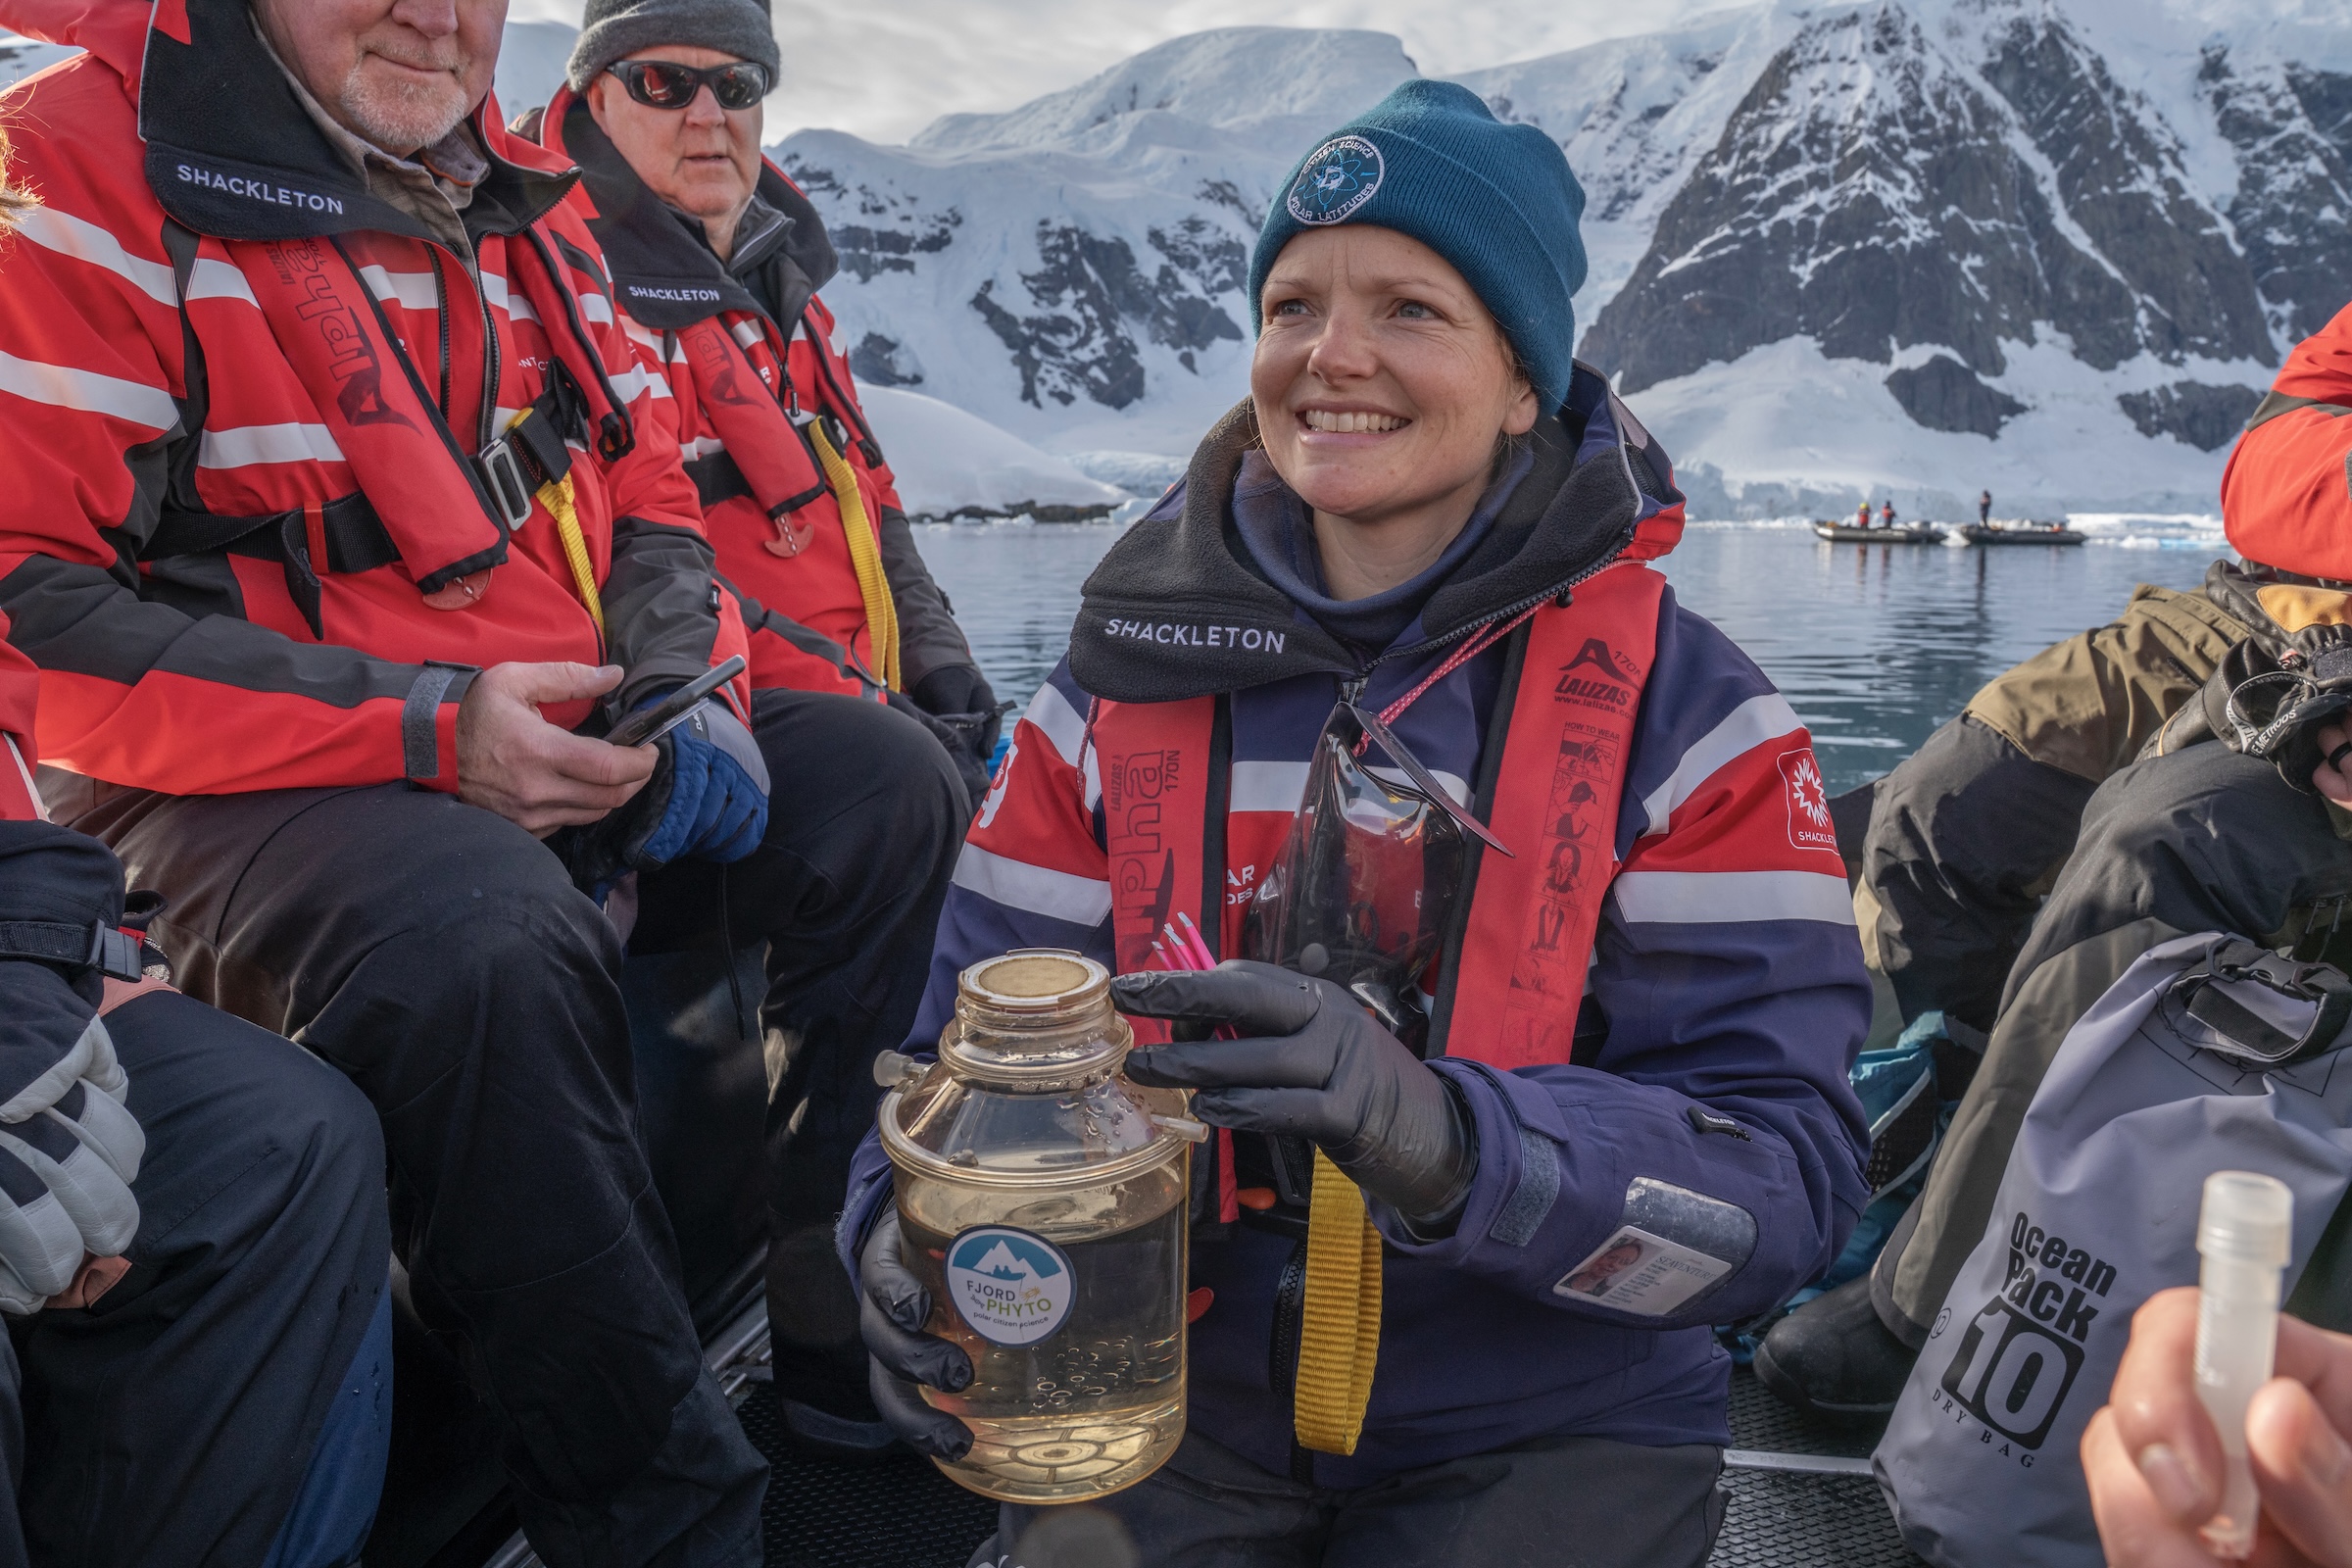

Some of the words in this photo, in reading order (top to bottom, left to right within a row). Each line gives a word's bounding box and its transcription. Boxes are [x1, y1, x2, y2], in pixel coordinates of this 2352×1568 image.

[1339, 140, 1374, 159] SCIENCE
[177, 164, 343, 215] SHACKLETON
[1290, 196, 1313, 220] POLAR
[1317, 182, 1375, 221] LATITUDES
[628, 285, 720, 302] SHACKLETON
[1104, 618, 1285, 654] SHACKLETON
[1554, 674, 1631, 707] LALIZAS
[1565, 721, 1584, 732] HOW
[1586, 725, 1596, 734] TO
[1597, 728, 1621, 742] WEAR
[1110, 762, 1124, 812] LALIZAS
[1164, 750, 1180, 793] 170N
[1798, 830, 1838, 847] SHACKLE
[2010, 1211, 2117, 1298] Ocean
[966, 1280, 1016, 1301] FJORD
[986, 1298, 1052, 1318] PHYTO
[2001, 1247, 2099, 1343] Pack
[973, 1311, 992, 1322] polar
[993, 1317, 1018, 1327] citizen
[1019, 1315, 1049, 1328] science
[1956, 1307, 2068, 1434] 10
[1932, 1388, 1968, 1424] DRY
[1980, 1429, 2035, 1468] BAG
